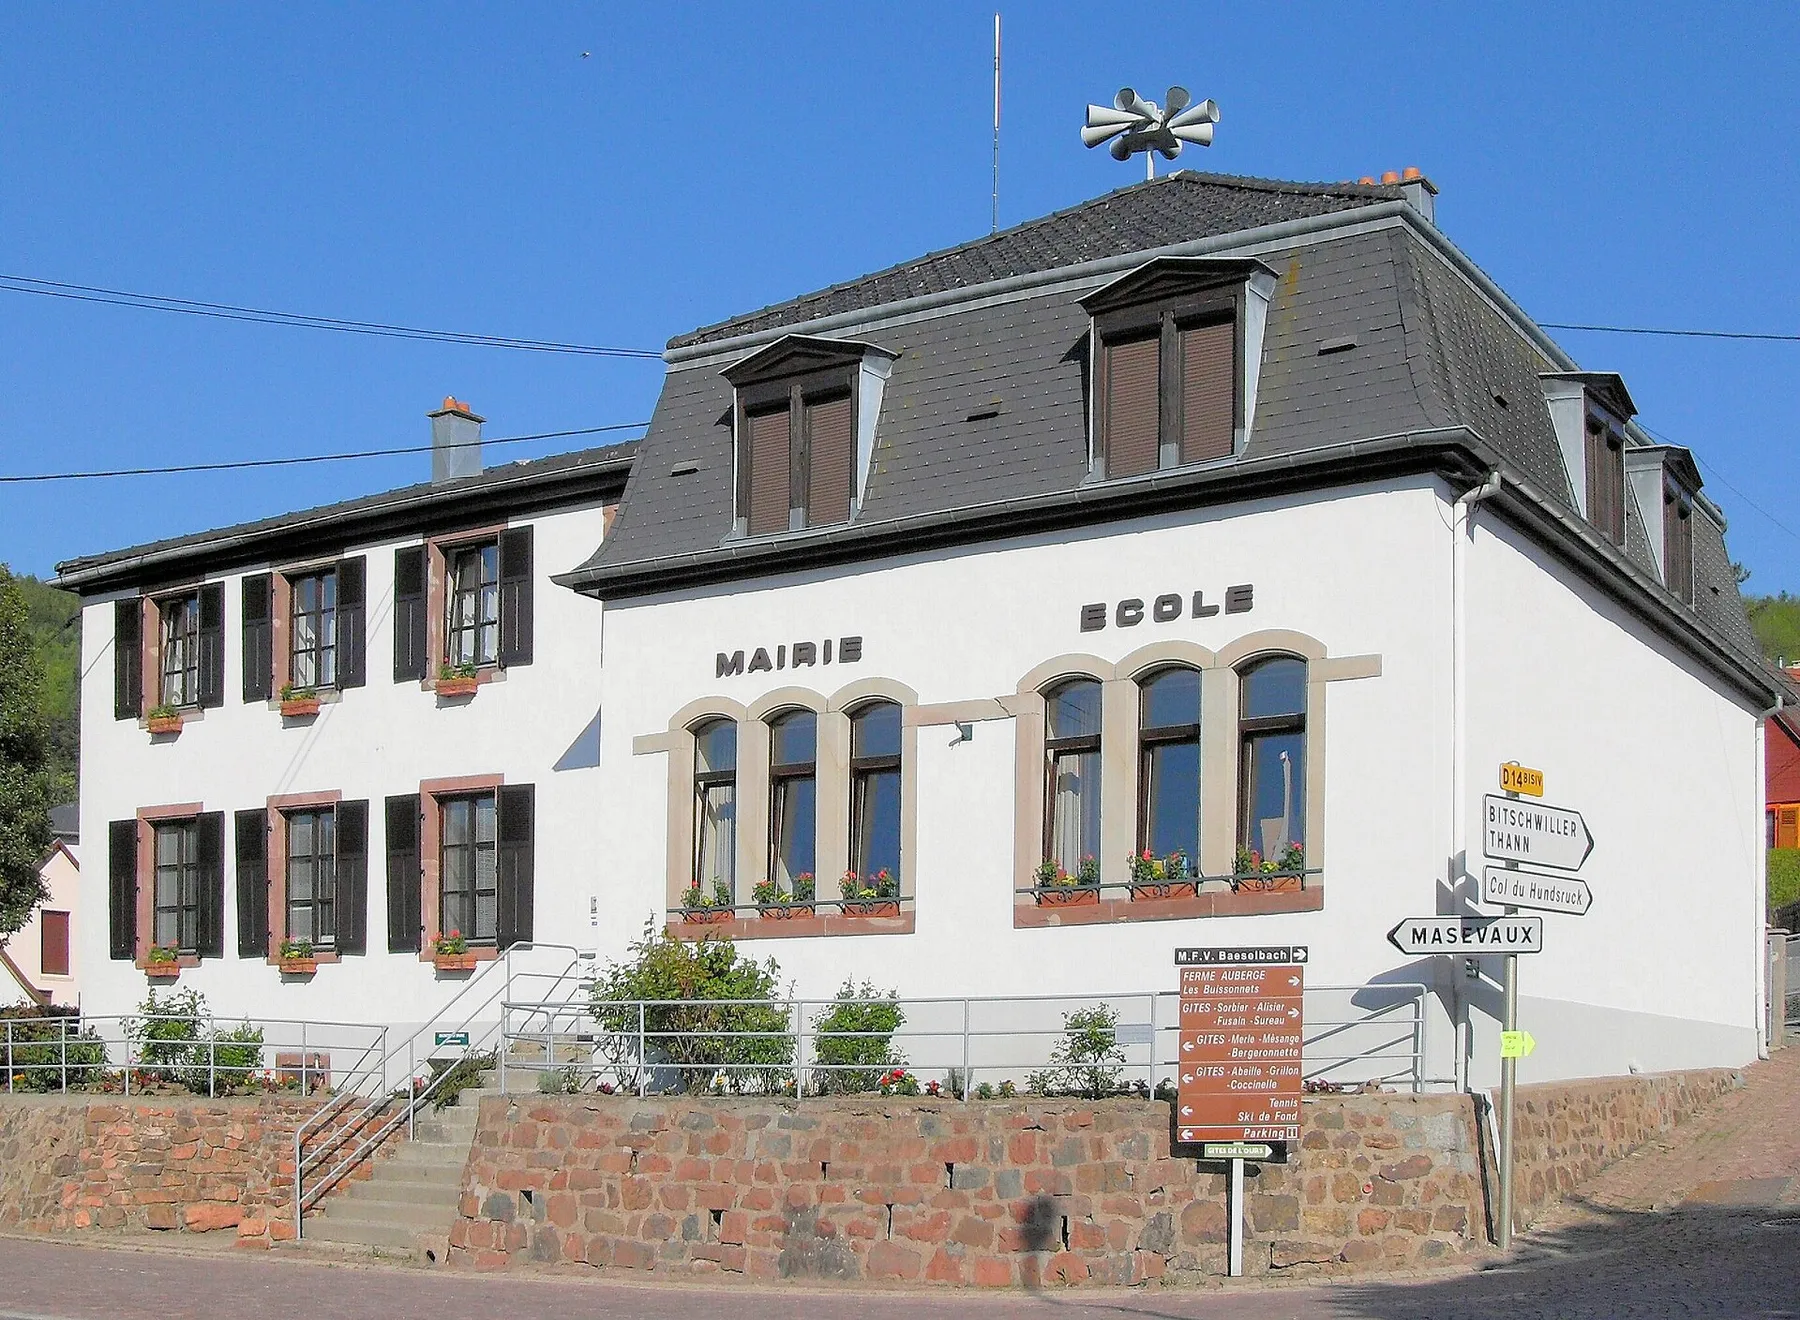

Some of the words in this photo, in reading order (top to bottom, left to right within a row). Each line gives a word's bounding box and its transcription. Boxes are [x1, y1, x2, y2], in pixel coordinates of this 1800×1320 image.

[1080, 584, 1254, 632] ECOLE
[716, 636, 862, 678] MAIRIE
[1489, 805, 1577, 838] BITSCHWILLER
[1490, 830, 1530, 853] THANN
[1490, 876, 1508, 895] Col
[1512, 880, 1525, 896] du
[1530, 883, 1582, 906] Hundsruck
[1411, 926, 1533, 945] MASEVAUX
[1178, 951, 1215, 961] M.F.V.
[1183, 971, 1216, 981] FERME
[1221, 970, 1266, 980] AUBERGE
[1183, 985, 1199, 995] Les
[1203, 984, 1260, 994] Buissonnets
[1182, 1003, 1211, 1013] GITES
[1196, 1034, 1225, 1045] GITES
[1196, 1066, 1225, 1077] GITES
[1269, 1098, 1298, 1108] Tennis
[1237, 1112, 1254, 1122] Ski
[1258, 1112, 1270, 1121] de
[1274, 1110, 1298, 1121] Fond
[1243, 1128, 1285, 1140] Parking
